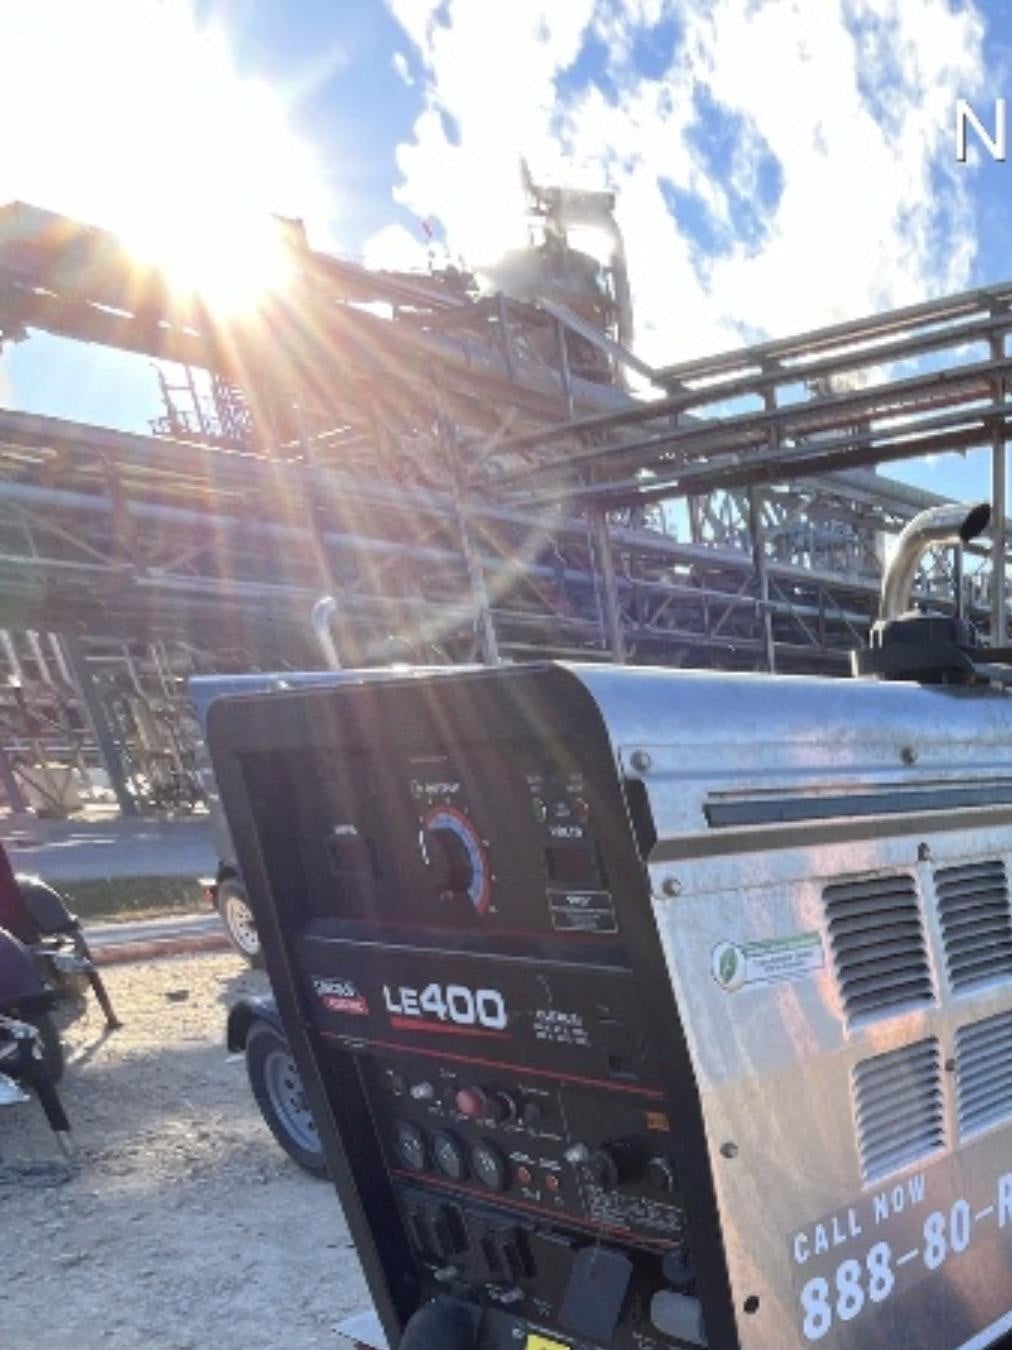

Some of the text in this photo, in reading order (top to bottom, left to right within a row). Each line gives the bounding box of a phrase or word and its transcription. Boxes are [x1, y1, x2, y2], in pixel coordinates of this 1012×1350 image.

[382, 982, 509, 1030] LE400
[793, 1173, 927, 1264] CALL NOW
